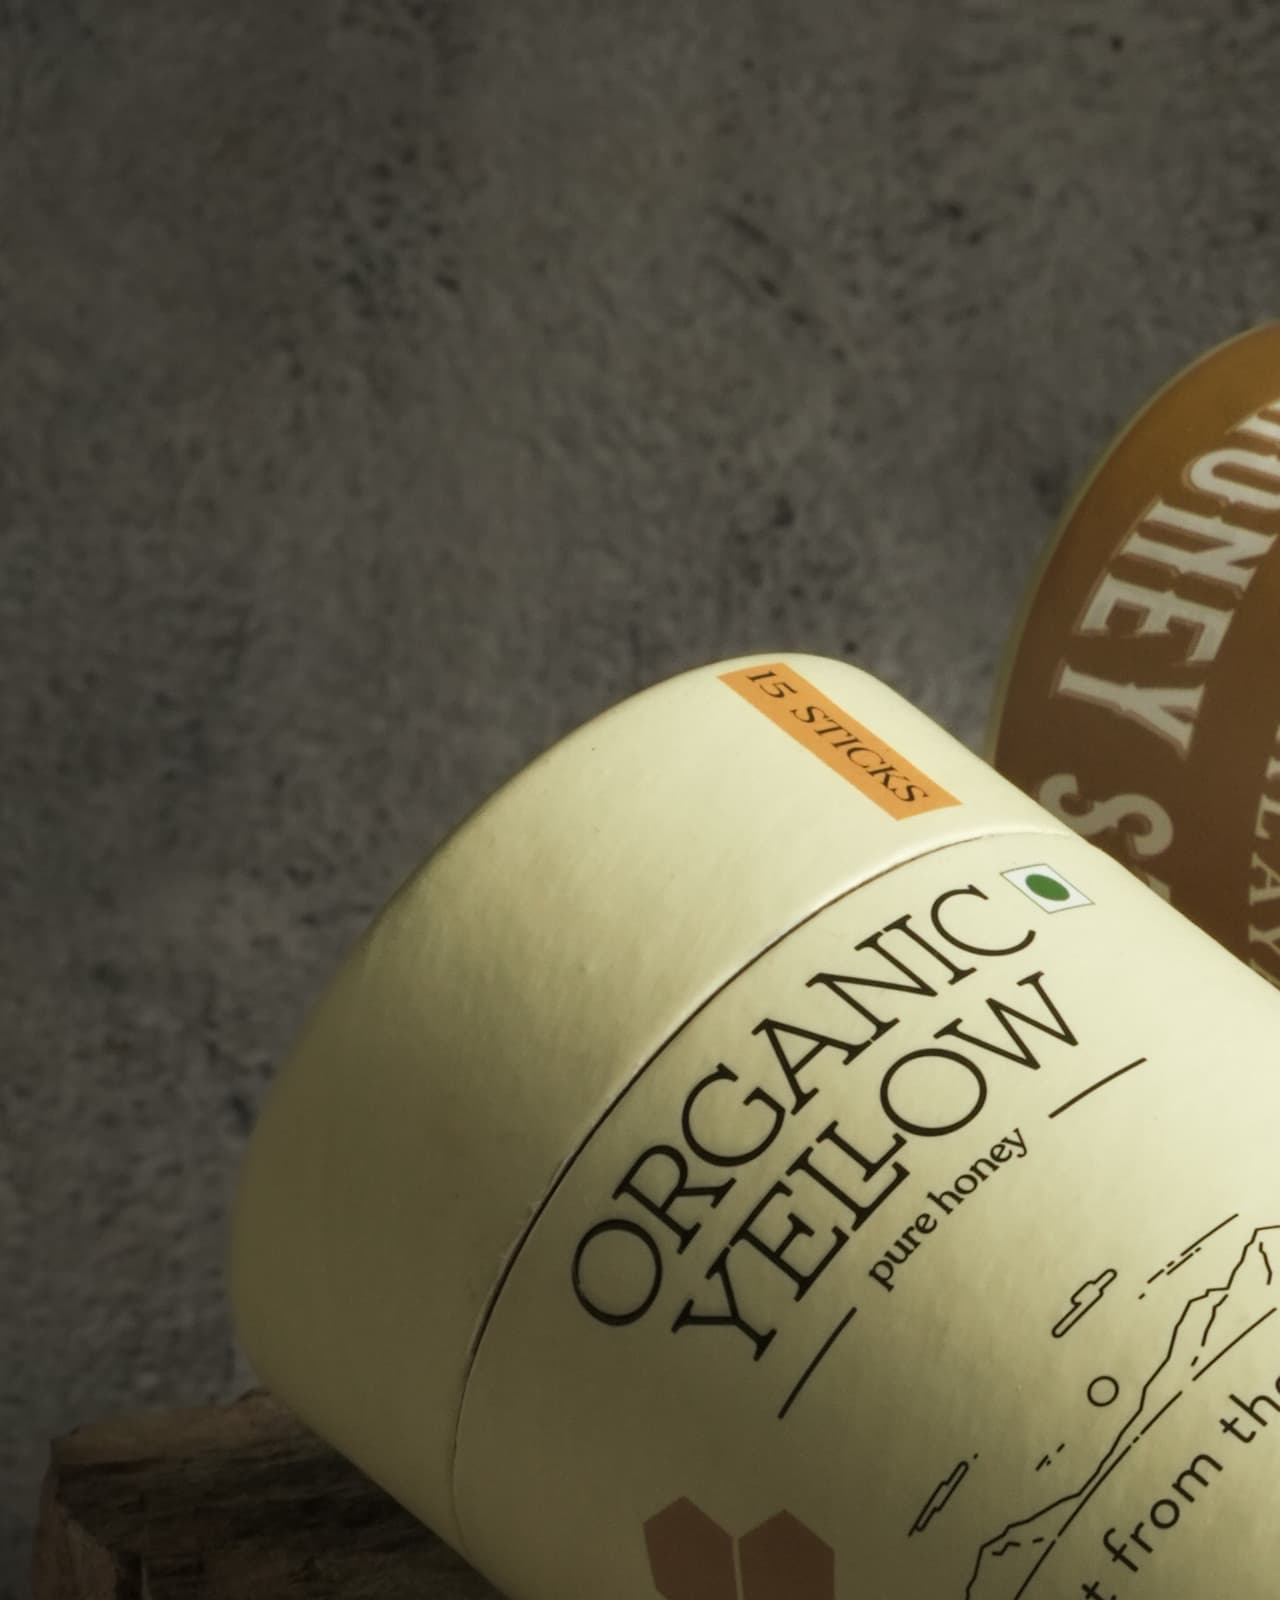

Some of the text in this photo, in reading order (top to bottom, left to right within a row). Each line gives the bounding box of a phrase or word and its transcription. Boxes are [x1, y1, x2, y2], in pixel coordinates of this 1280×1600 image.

[745, 668, 929, 805] 15 STICKS
[571, 884, 1037, 1327] ORGANIC
[671, 972, 1079, 1362] YELLOW
[867, 1127, 1030, 1292] pure honey
[1102, 1451, 1224, 1573] from
